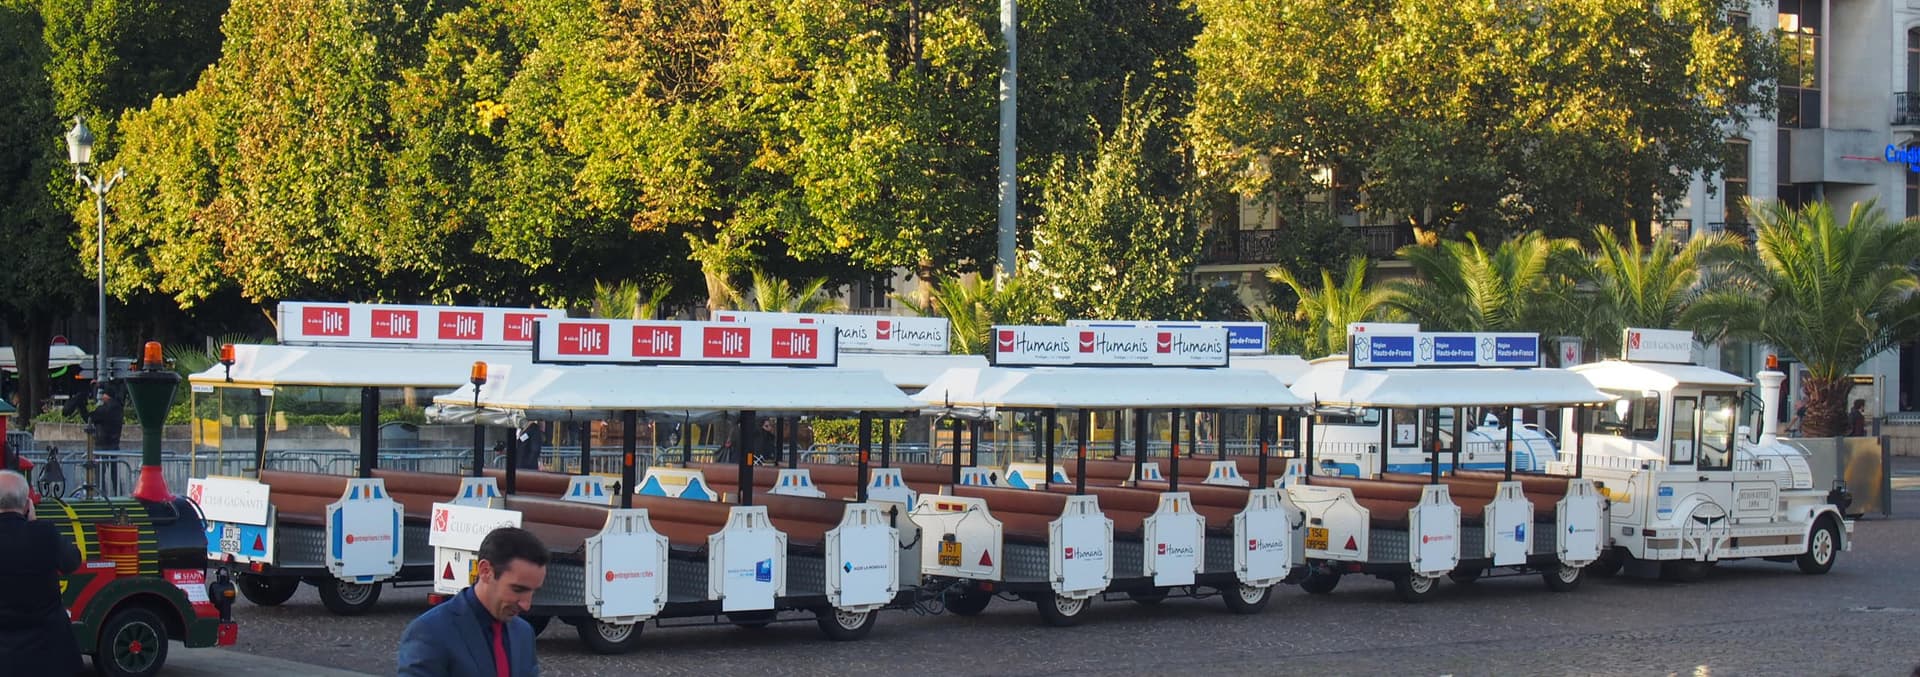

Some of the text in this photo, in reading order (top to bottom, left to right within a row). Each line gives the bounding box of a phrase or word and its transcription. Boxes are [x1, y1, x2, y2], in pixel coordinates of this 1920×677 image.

[892, 321, 942, 342] Humanis
[1016, 331, 1070, 355] Humanis
[1096, 332, 1148, 355] Humanis
[1173, 333, 1222, 355] Humanis
[1373, 349, 1412, 357] Hauts-de-France
[1435, 349, 1474, 357] Hauts-de-France
[1497, 349, 1534, 357] Hauts-de-France
[1403, 430, 1409, 440] 2
[1073, 546, 1103, 559] Humanis
[1167, 543, 1194, 556] Humanis
